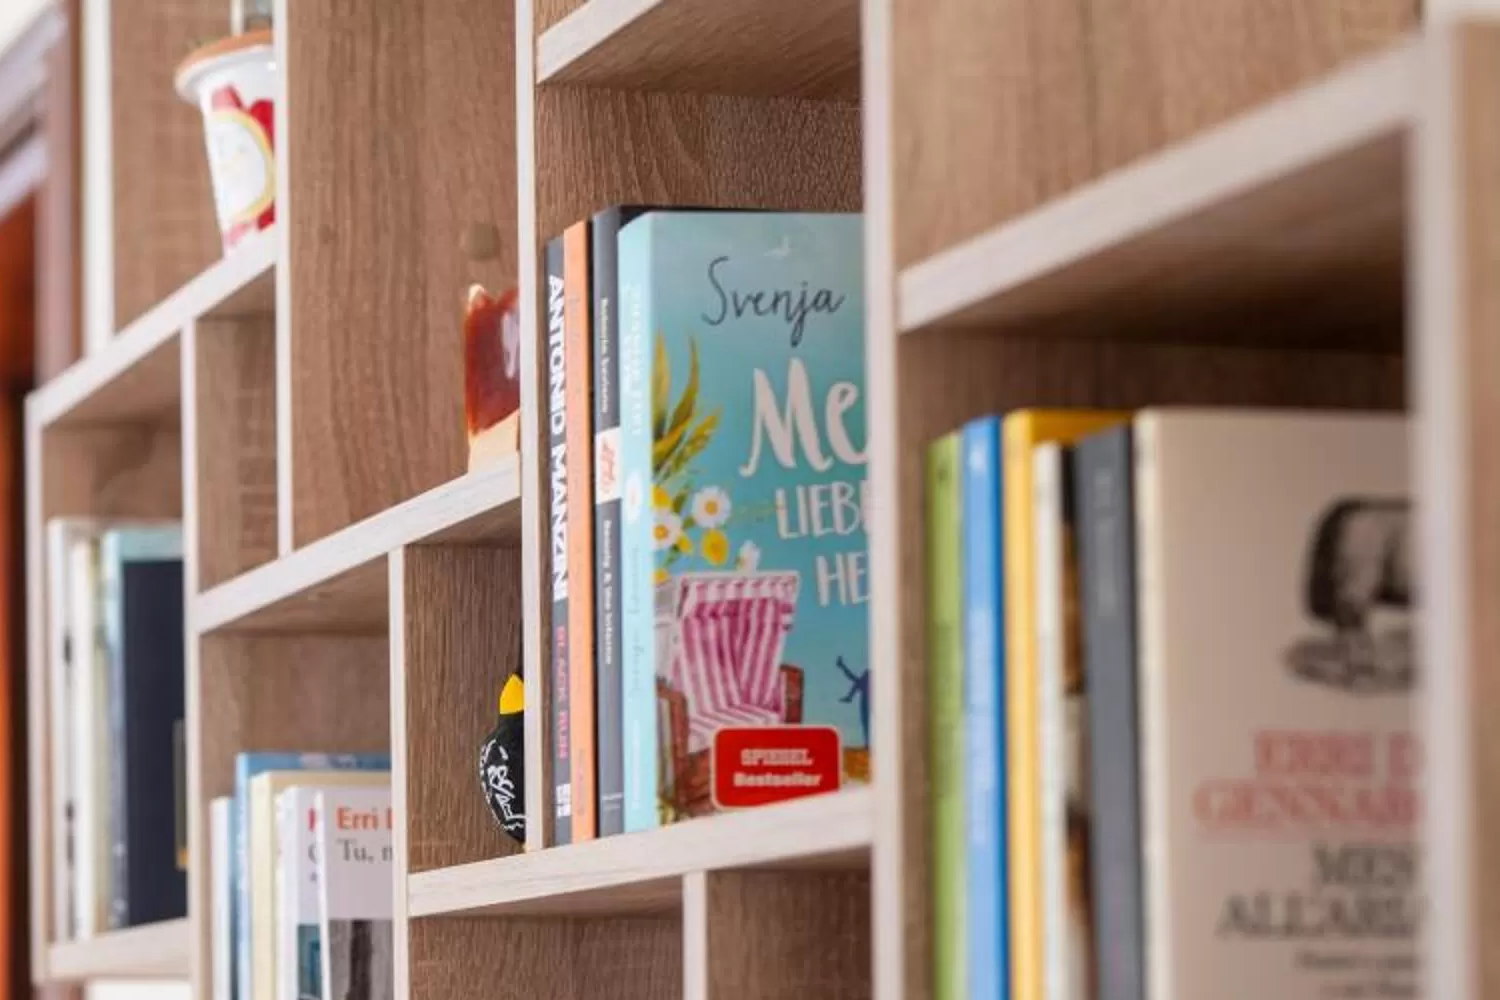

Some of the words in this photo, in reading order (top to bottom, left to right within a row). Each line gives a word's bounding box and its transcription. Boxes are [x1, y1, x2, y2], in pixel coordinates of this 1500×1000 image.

[702, 255, 847, 348] Svenja
[548, 273, 567, 435] ANTONIO
[551, 442, 570, 602] MANZINI
[336, 804, 379, 831] Erri
[336, 838, 374, 864] Tu,
